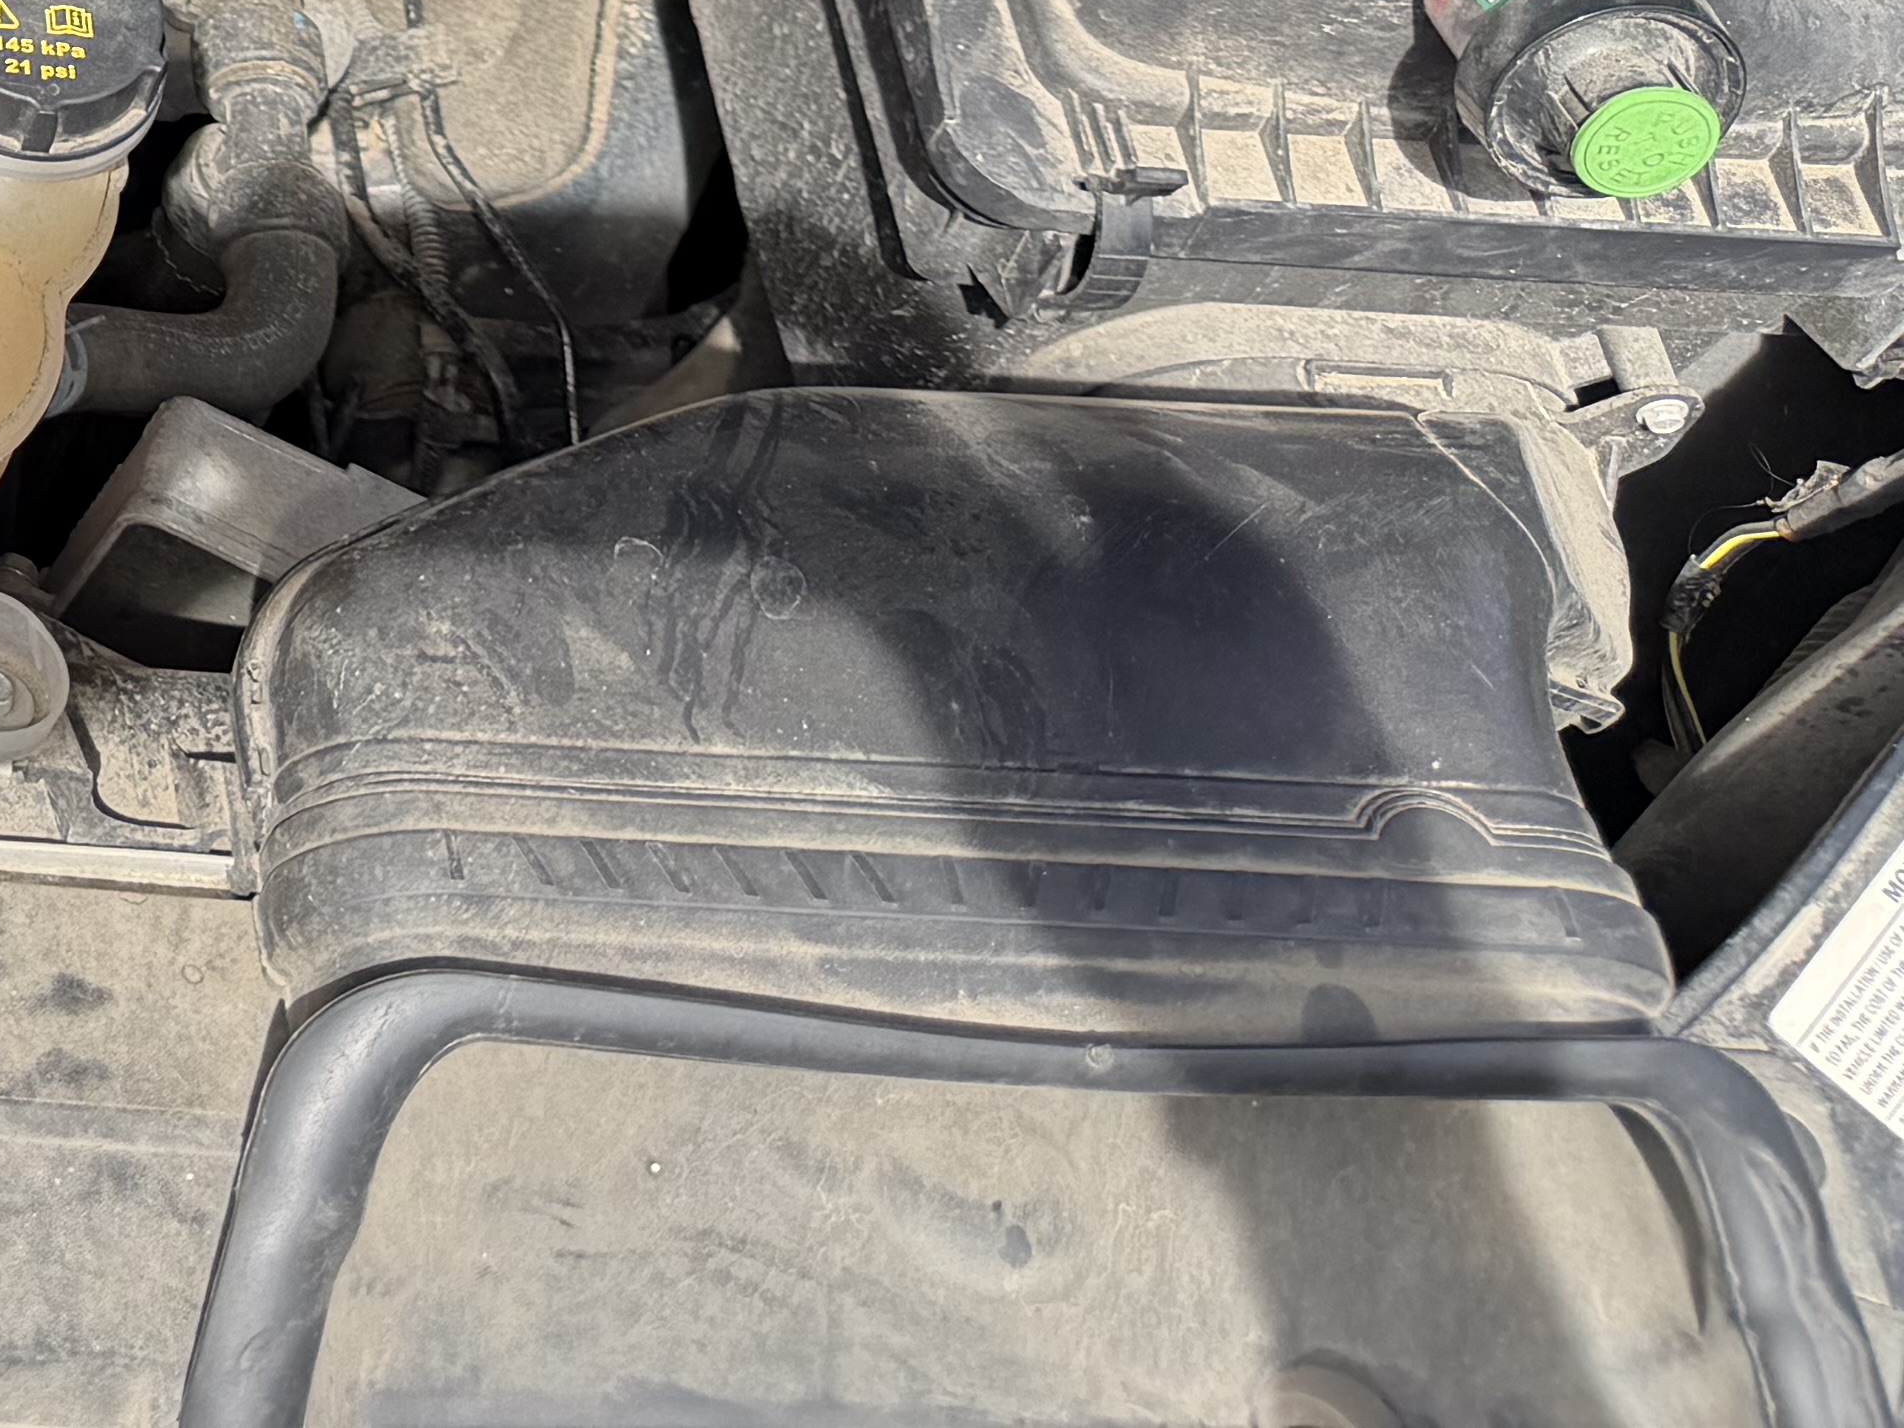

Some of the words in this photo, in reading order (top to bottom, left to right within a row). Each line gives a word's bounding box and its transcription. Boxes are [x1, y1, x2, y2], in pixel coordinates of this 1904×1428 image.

[40, 40, 87, 59] kPa
[4, 58, 31, 76] 21
[40, 64, 77, 81] psi
[1596, 124, 1649, 186] RESET
[1642, 129, 1665, 168] TO
[1654, 110, 1700, 169] PUSH
